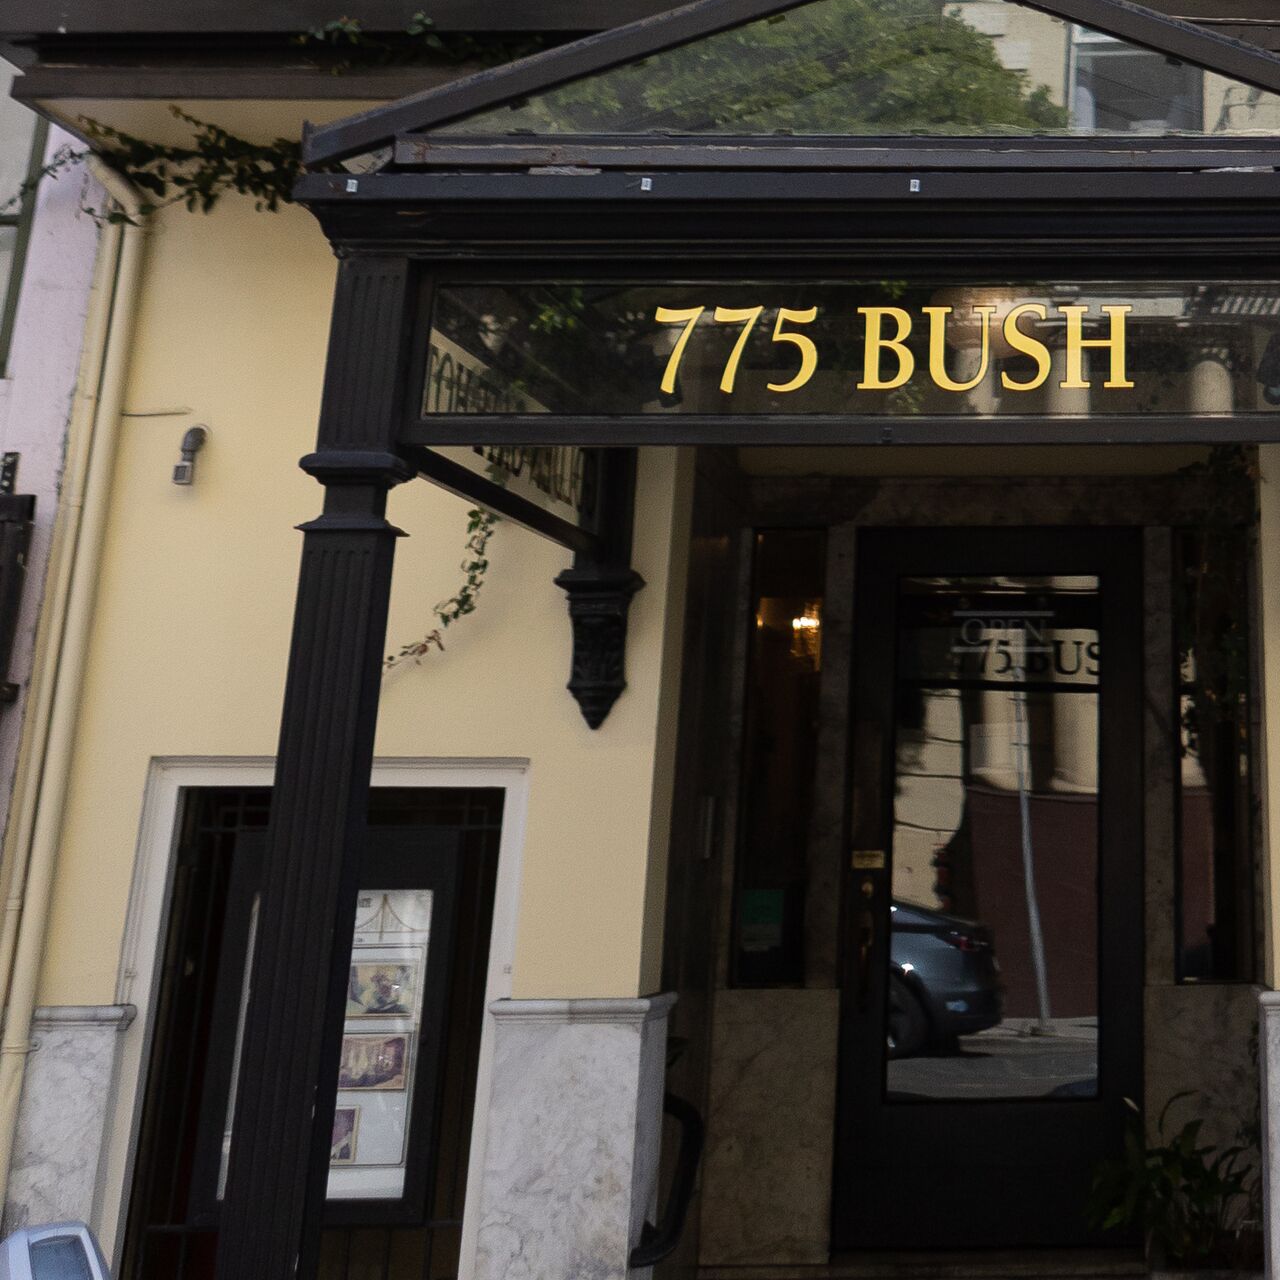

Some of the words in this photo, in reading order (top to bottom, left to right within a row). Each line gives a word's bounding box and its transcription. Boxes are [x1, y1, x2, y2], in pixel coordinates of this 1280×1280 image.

[653, 305, 818, 395] 775
[857, 303, 1134, 391] BUSH
[961, 618, 1048, 645] OPEN
[1027, 640, 1101, 675] BUS
